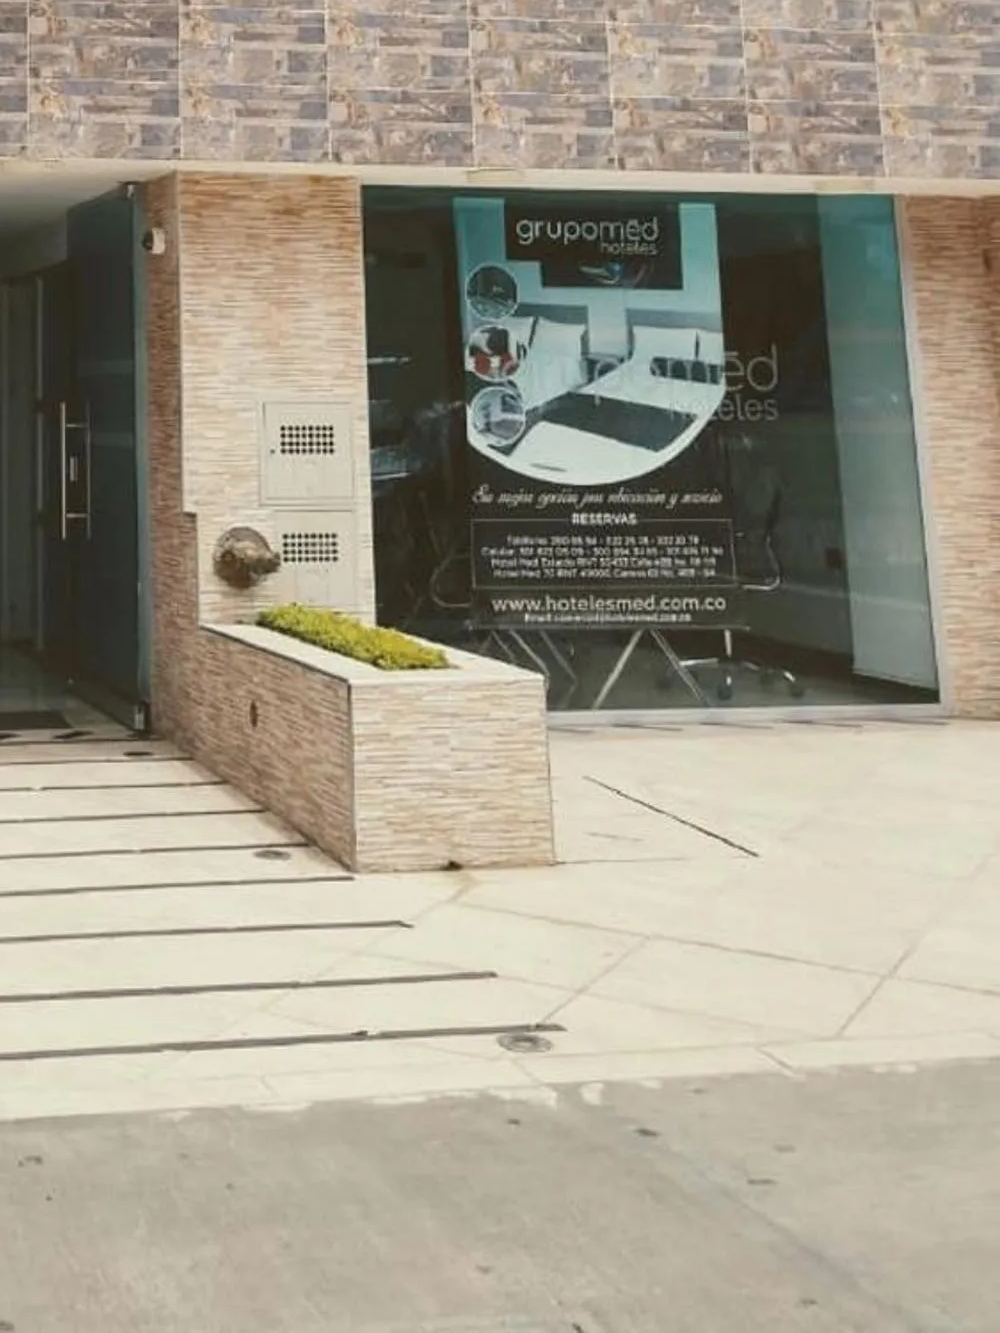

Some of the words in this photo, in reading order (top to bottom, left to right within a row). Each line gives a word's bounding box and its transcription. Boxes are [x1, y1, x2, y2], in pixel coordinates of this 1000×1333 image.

[601, 241, 658, 256] hoteles
[571, 512, 638, 526] RESERVAS
[491, 594, 727, 613] www.hotelesmed.com.co
